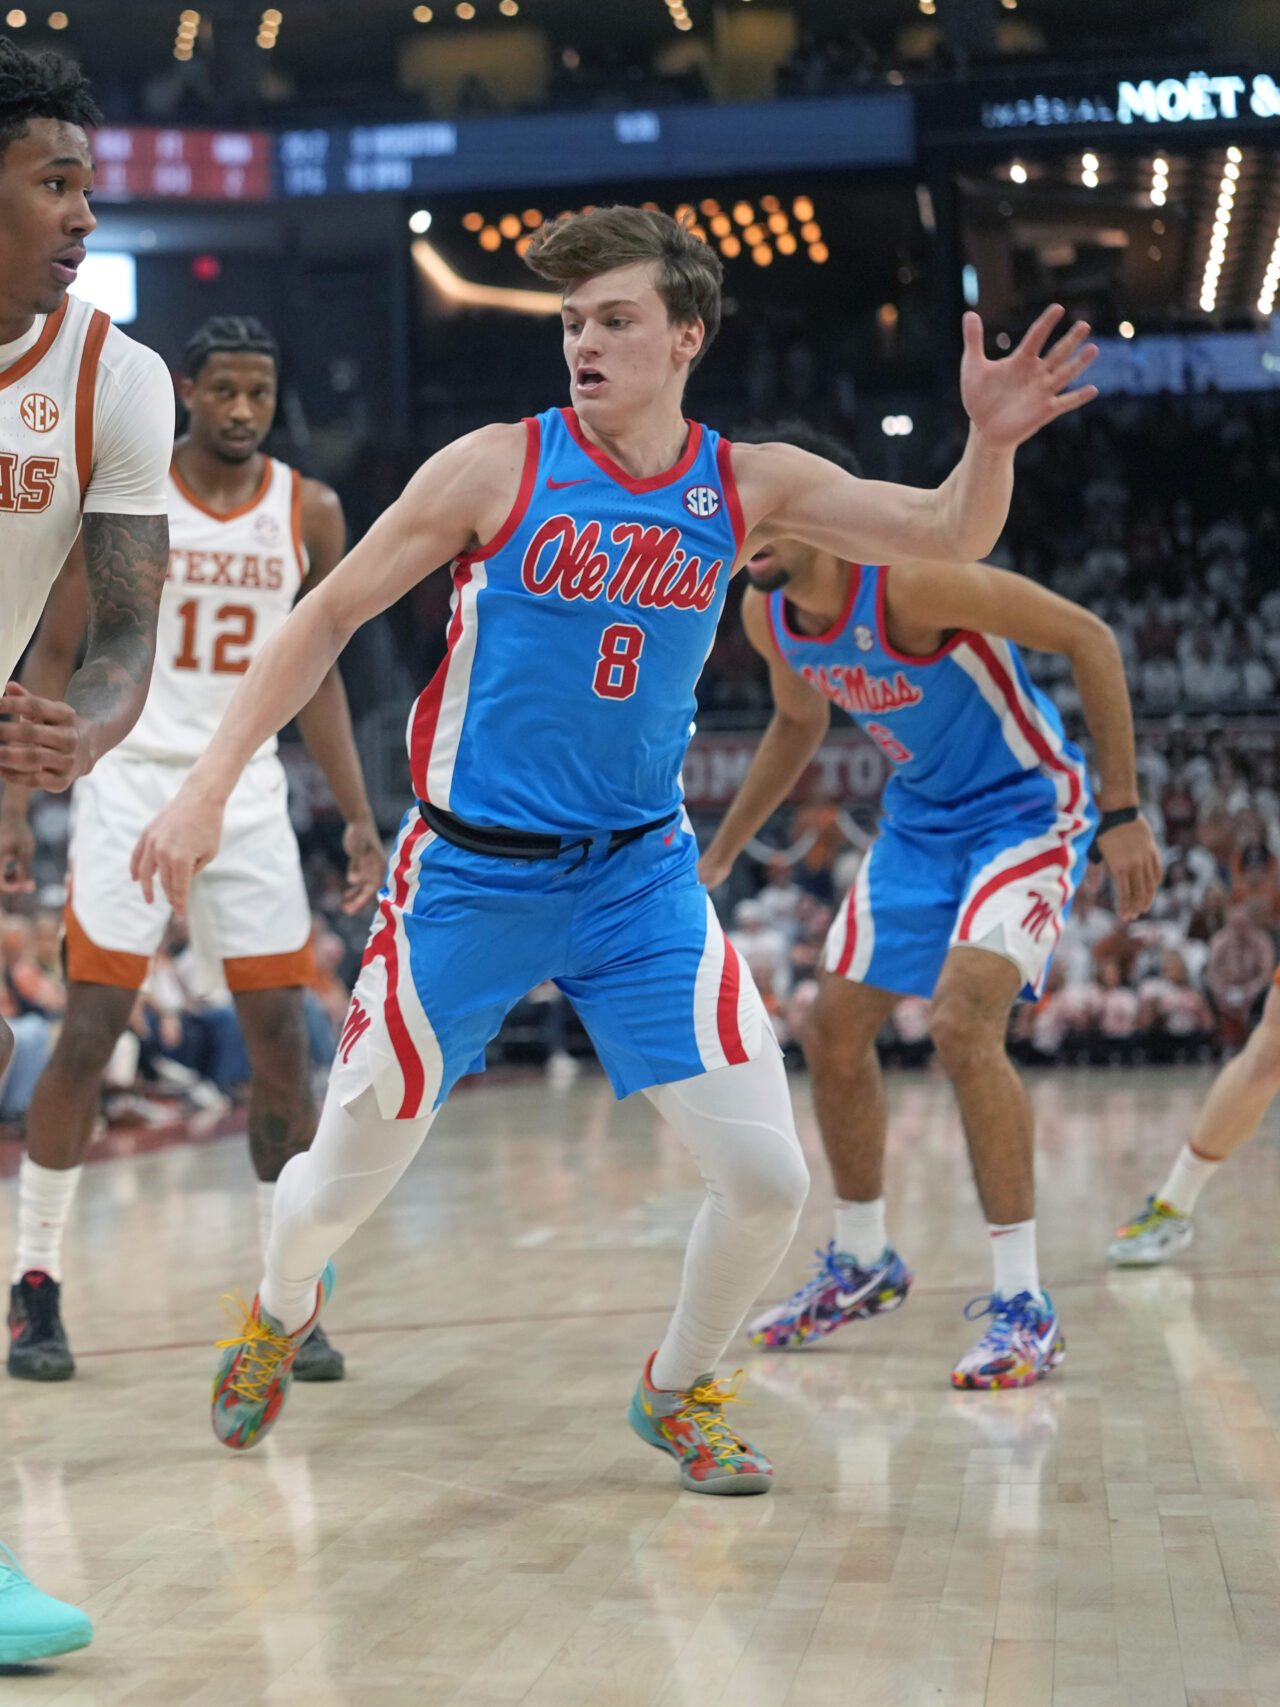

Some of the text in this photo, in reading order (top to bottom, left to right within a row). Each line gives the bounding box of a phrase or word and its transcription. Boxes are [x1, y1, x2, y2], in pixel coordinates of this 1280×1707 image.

[1117, 70, 1246, 124] MOËT
[1250, 74, 1280, 118] &
[23, 396, 57, 430] SEC
[685, 487, 719, 516] SEC
[166, 548, 284, 592] TEXAS
[521, 513, 723, 612] Ole Miss
[173, 597, 257, 676] 12
[591, 622, 646, 702] 8
[830, 663, 923, 715] Miss
